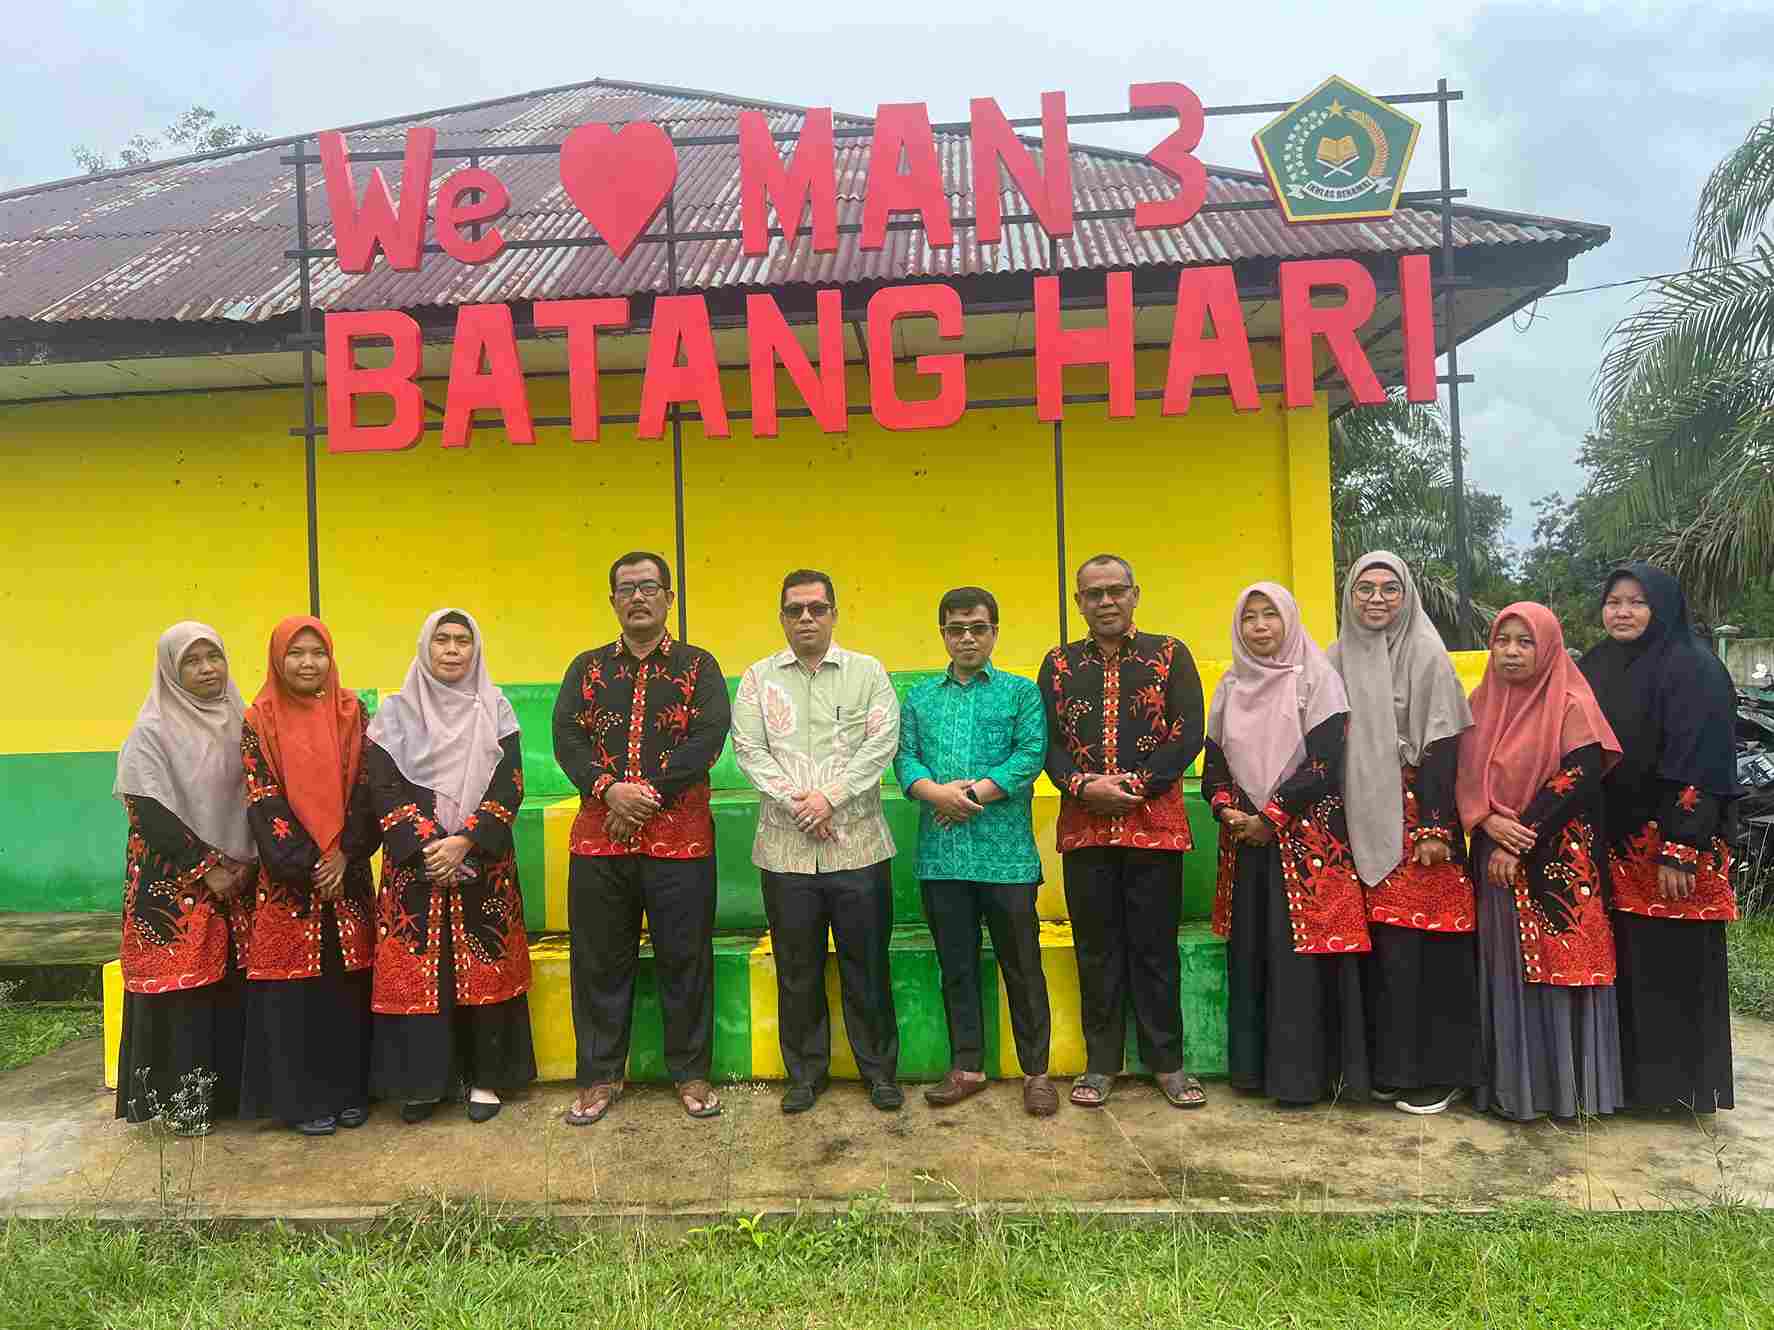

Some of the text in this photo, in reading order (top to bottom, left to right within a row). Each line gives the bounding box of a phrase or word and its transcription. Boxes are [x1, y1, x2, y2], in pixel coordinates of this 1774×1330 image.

[319, 81, 1208, 273] We MAN 3
[324, 254, 1438, 454] BATANG HARI
